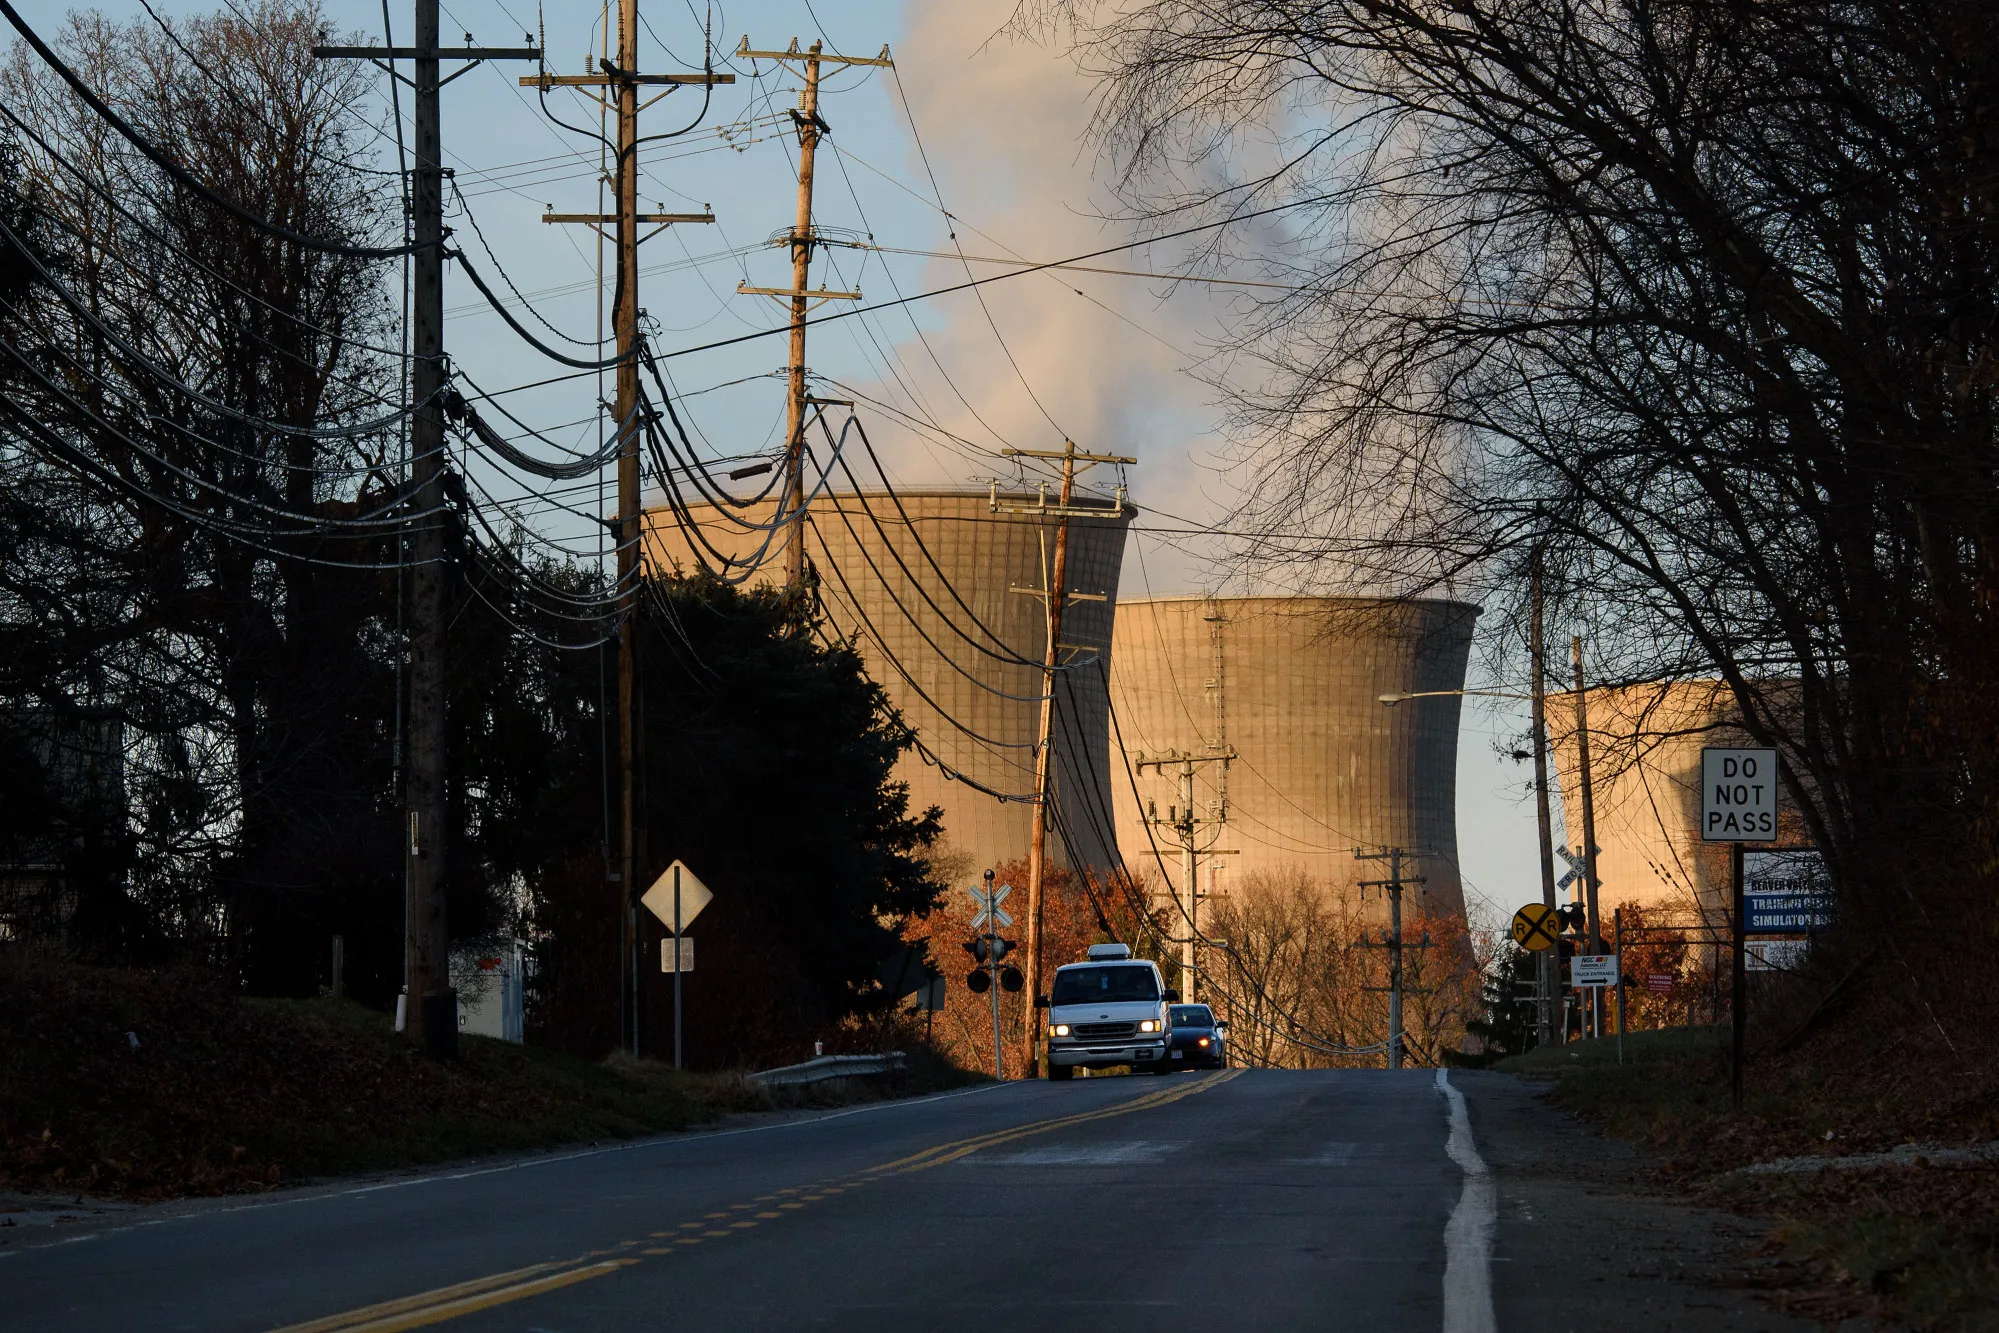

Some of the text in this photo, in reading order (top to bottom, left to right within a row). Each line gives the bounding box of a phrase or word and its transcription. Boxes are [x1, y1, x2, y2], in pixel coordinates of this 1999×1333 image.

[1724, 758, 1757, 778] DO
[1716, 785, 1764, 805] NOT
[1708, 812, 1772, 832] PASS
[1752, 898, 1801, 910] TRAINING
[1516, 920, 1557, 935] R R
[1752, 915, 1811, 926] SIMULATOR
